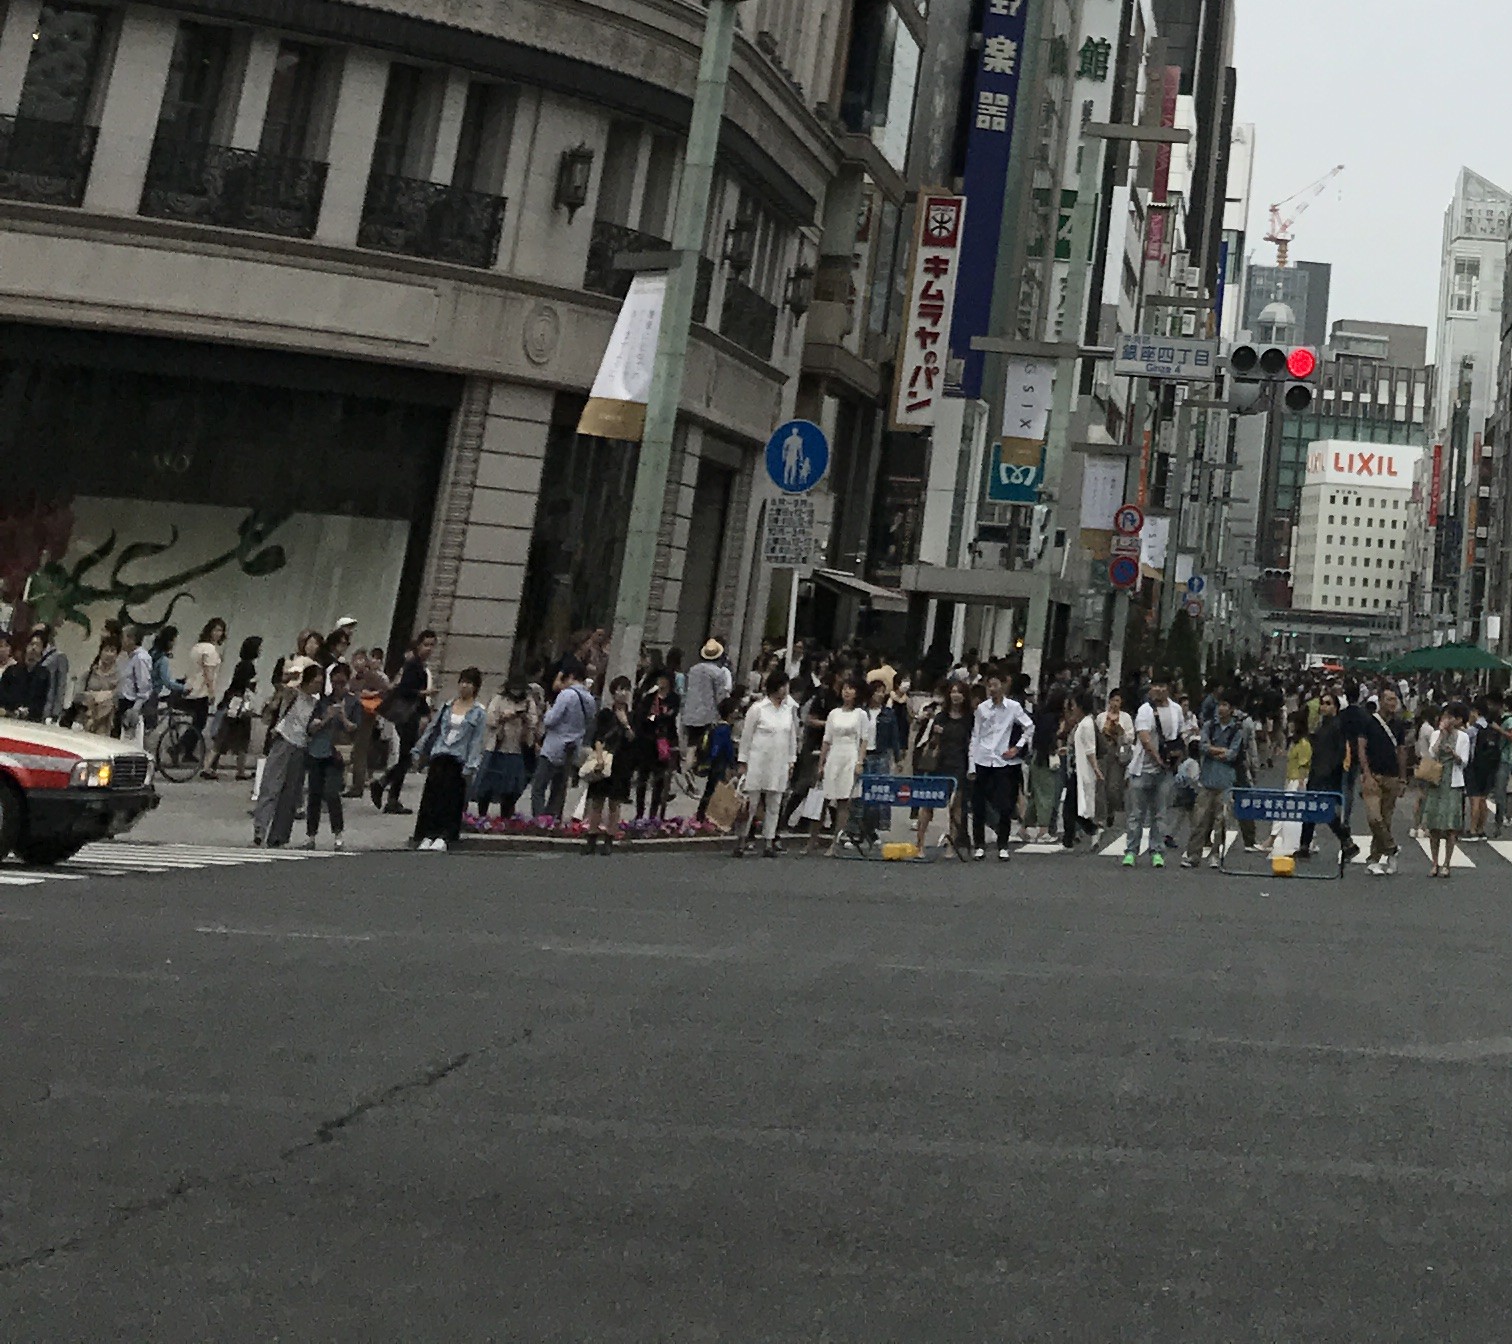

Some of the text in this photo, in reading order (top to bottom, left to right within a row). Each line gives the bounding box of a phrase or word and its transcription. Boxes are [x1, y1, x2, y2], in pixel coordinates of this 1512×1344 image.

[905, 255, 950, 413] キムラヤのパン
[1121, 344, 1209, 366] 銀座四丁目
[1333, 452, 1398, 477] LIXIL
